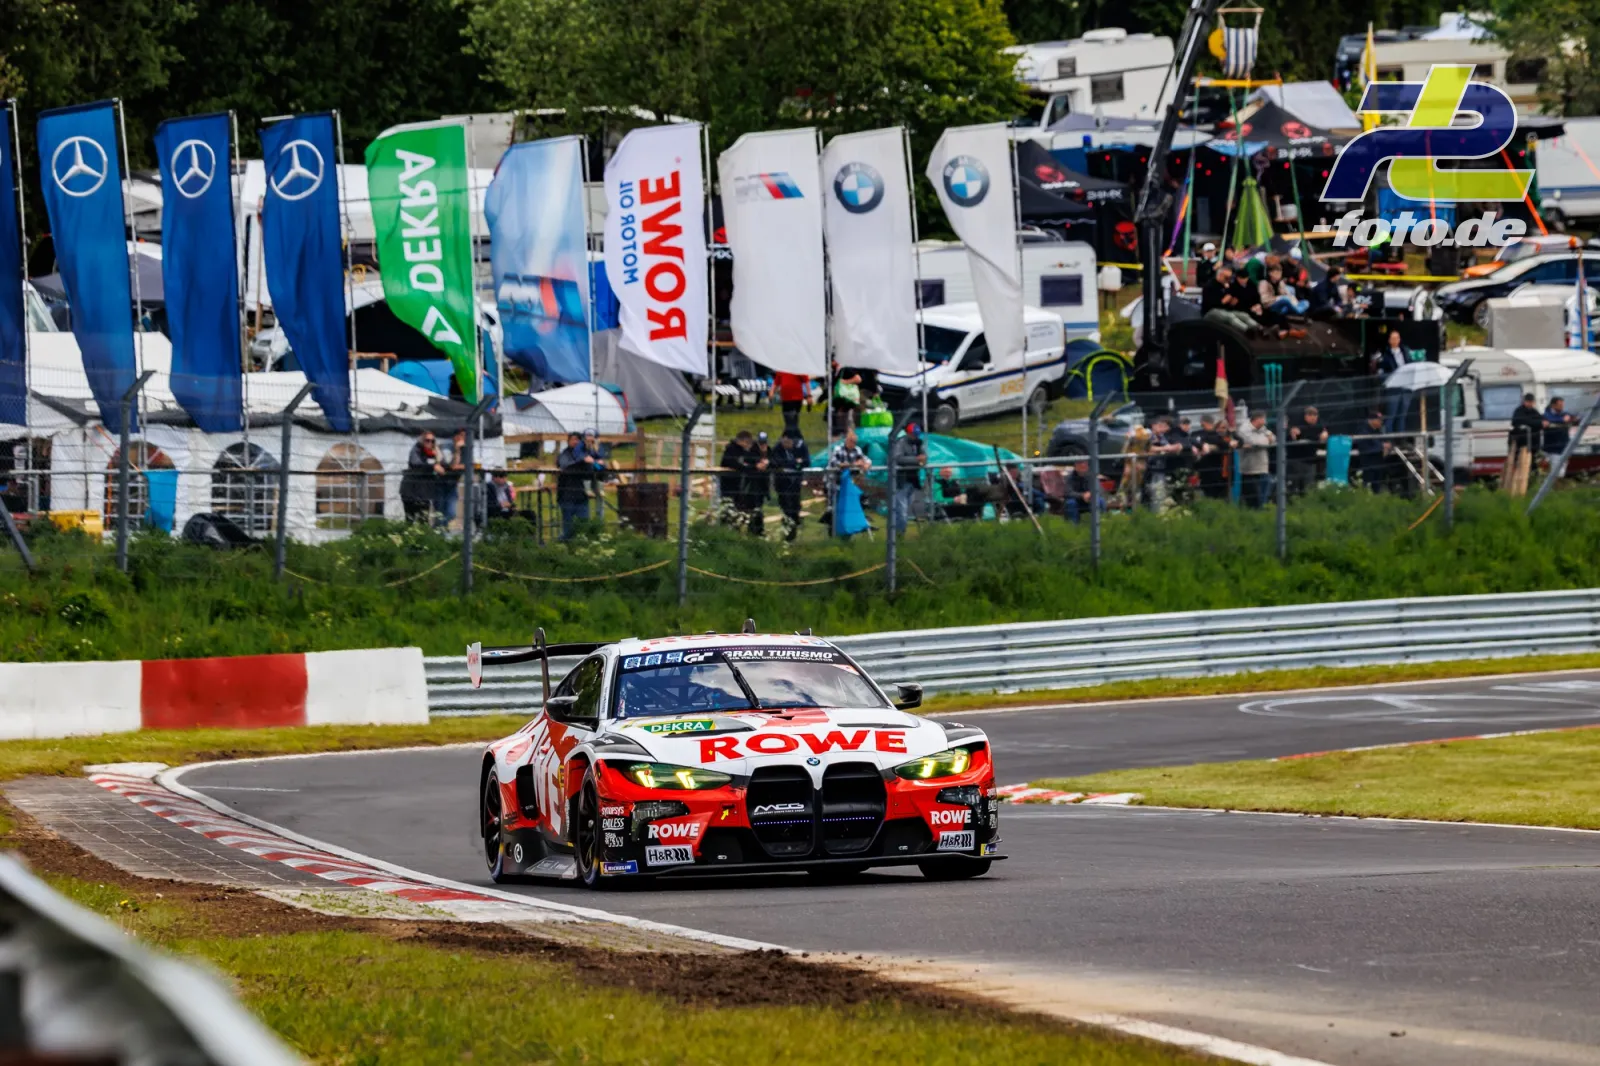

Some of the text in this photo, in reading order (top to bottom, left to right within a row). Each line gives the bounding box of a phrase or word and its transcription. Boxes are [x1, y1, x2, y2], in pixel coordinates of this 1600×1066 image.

[723, 649, 764, 659] GRAN
[650, 721, 706, 733] DEKRA
[694, 729, 908, 764] ROWE
[929, 810, 972, 825] ROWE
[647, 822, 701, 839] ROWE
